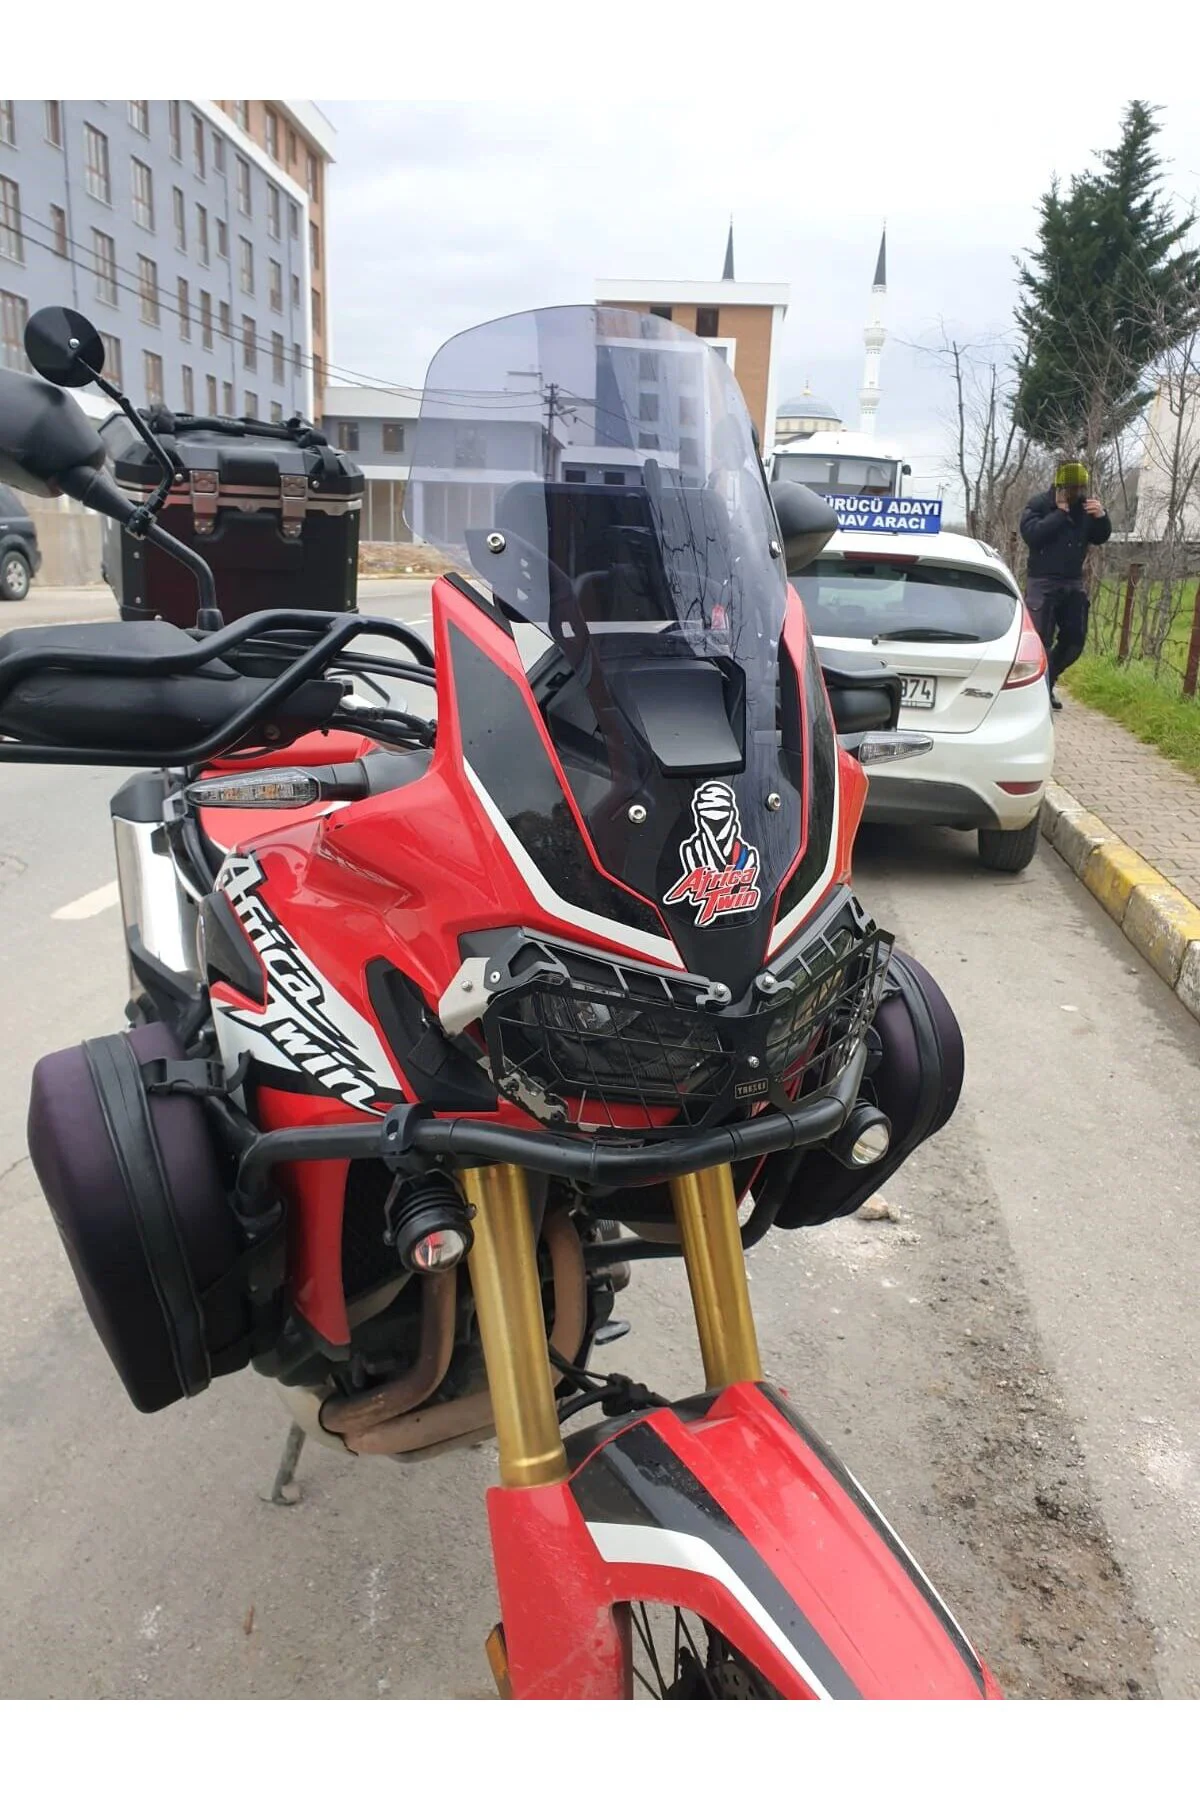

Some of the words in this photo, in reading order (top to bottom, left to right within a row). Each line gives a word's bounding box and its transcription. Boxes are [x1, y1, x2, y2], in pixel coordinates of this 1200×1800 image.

[823, 495, 883, 513] ÜRÜCÜ
[887, 501, 939, 516] ADAYI
[837, 514, 868, 527] NAV
[872, 516, 926, 530] ARACI
[667, 865, 757, 901] Africa
[699, 885, 758, 925] Twin
[213, 850, 341, 1038] Africa
[228, 984, 388, 1117] Twin
